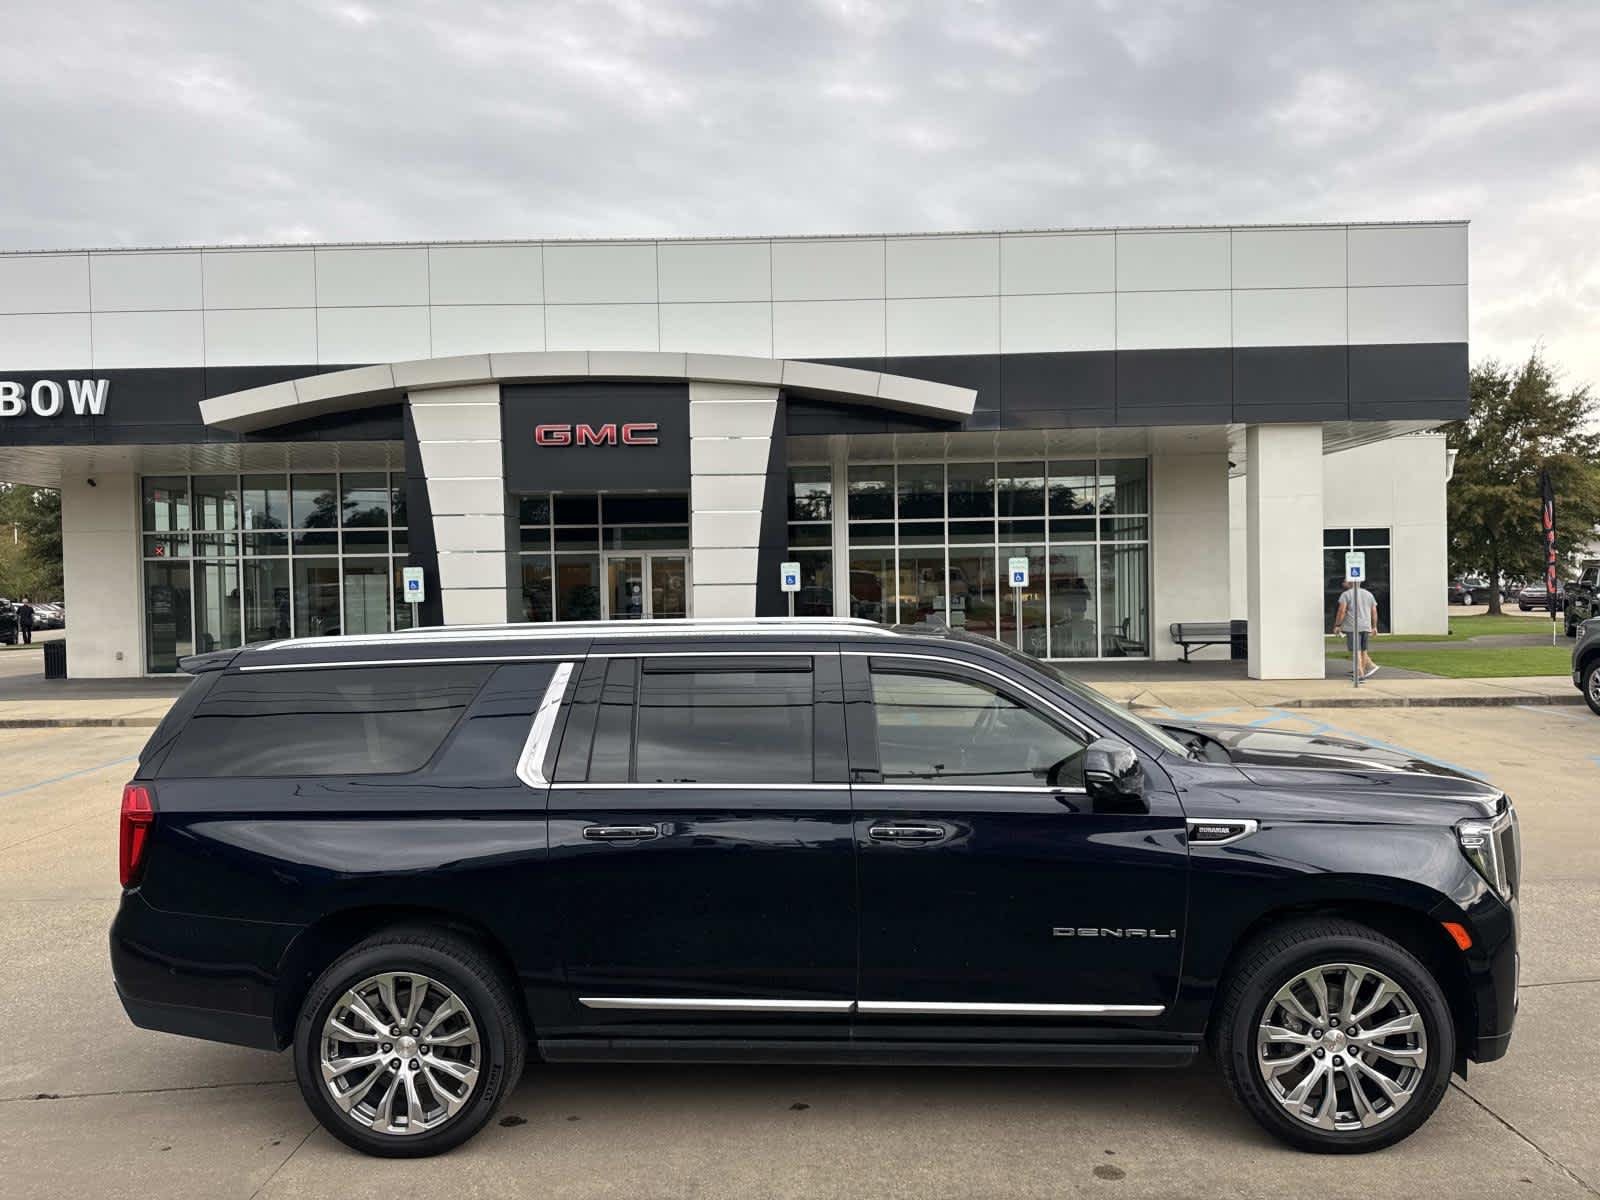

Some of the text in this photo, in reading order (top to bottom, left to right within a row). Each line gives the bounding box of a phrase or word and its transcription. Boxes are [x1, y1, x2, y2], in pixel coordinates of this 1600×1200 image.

[0, 379, 110, 416] BOW
[535, 423, 658, 446] GMC
[1052, 927, 1177, 938] DENALI
